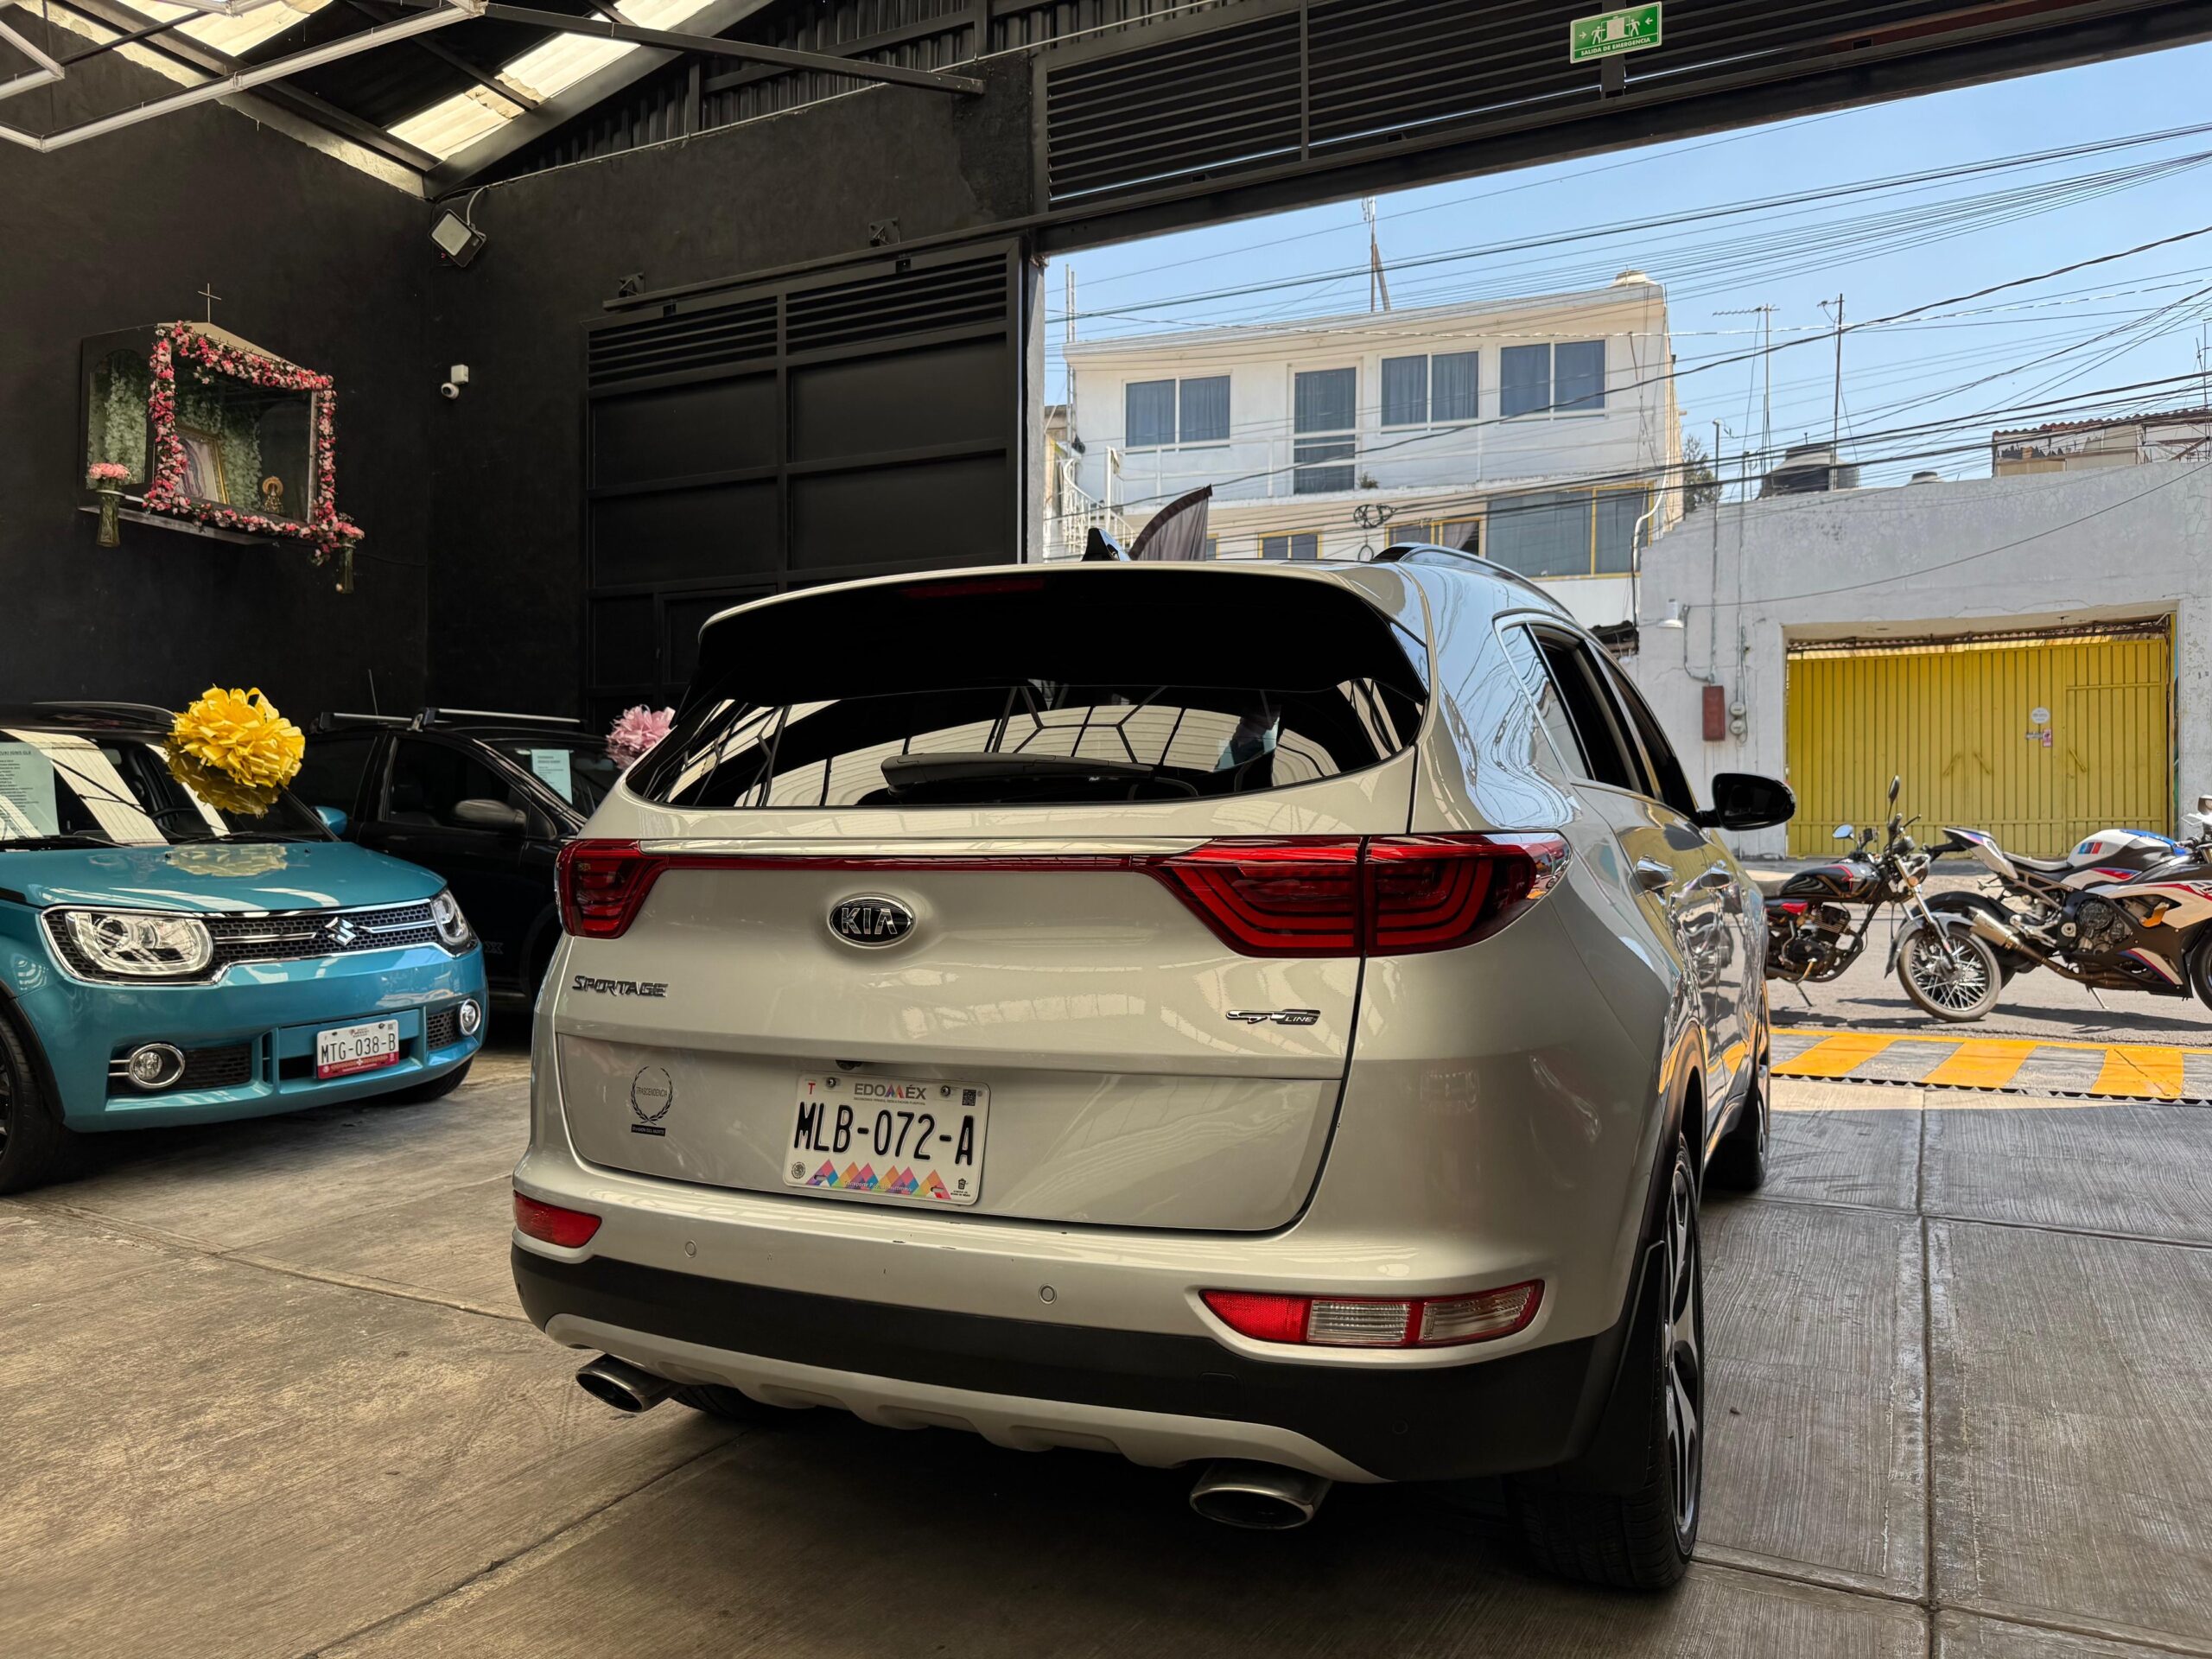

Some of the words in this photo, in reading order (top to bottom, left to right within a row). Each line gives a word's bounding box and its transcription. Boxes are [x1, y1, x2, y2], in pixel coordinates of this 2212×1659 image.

[1580, 47, 1602, 56] SALIDA
[1612, 36, 1651, 50] EMERGENCIA
[842, 907, 898, 935] KIA
[572, 975, 669, 998] SPORTAGE
[321, 1033, 397, 1065] MTG-038-B
[808, 1082, 817, 1096] T
[793, 1101, 975, 1166] MLB-072-A
